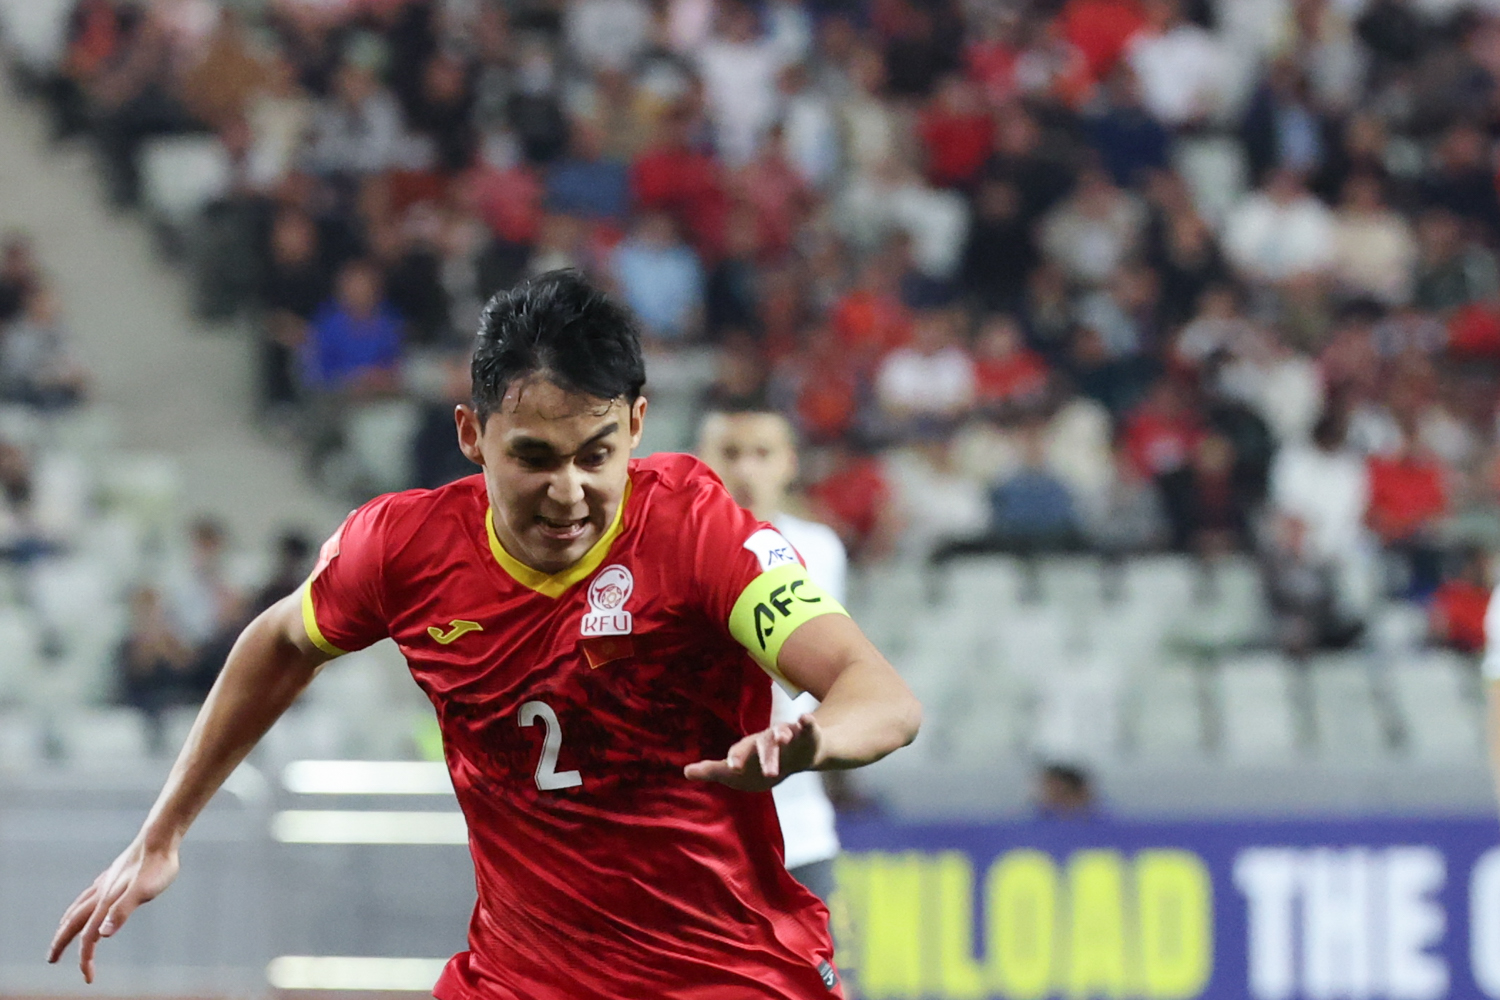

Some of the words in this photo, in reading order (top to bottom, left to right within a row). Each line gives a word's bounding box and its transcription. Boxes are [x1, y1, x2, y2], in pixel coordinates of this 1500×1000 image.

[768, 547, 794, 567] AFC
[584, 615, 628, 632] KFU
[754, 580, 821, 652] AFC
[517, 700, 582, 791] 2
